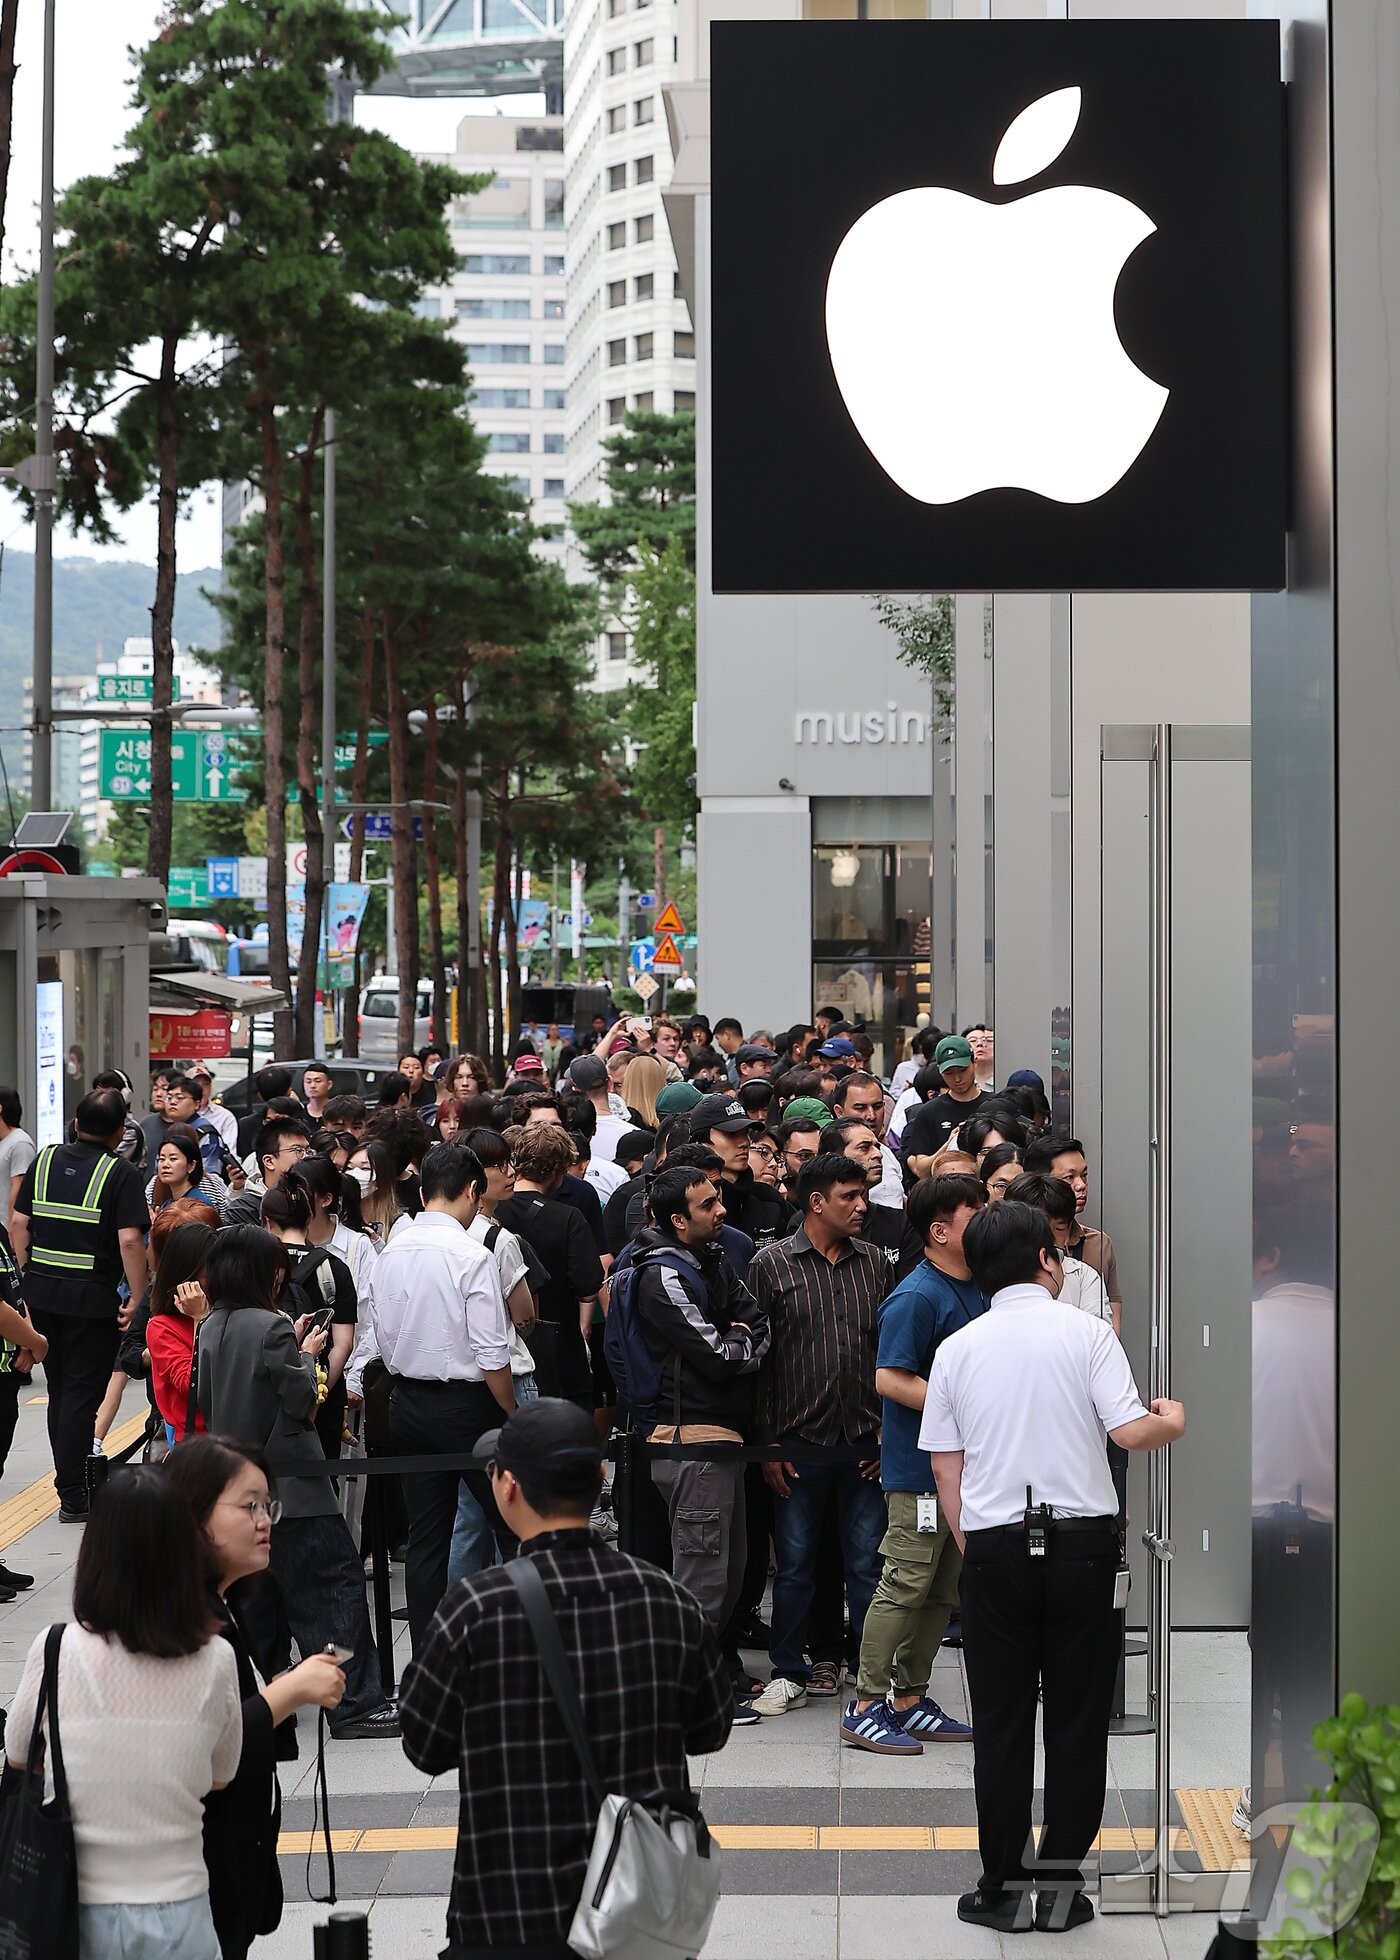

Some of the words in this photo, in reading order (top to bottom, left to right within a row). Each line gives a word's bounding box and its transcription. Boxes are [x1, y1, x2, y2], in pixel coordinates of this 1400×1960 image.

[102, 679, 147, 698] 을지로
[795, 701, 930, 744] musin
[115, 759, 141, 775] City
